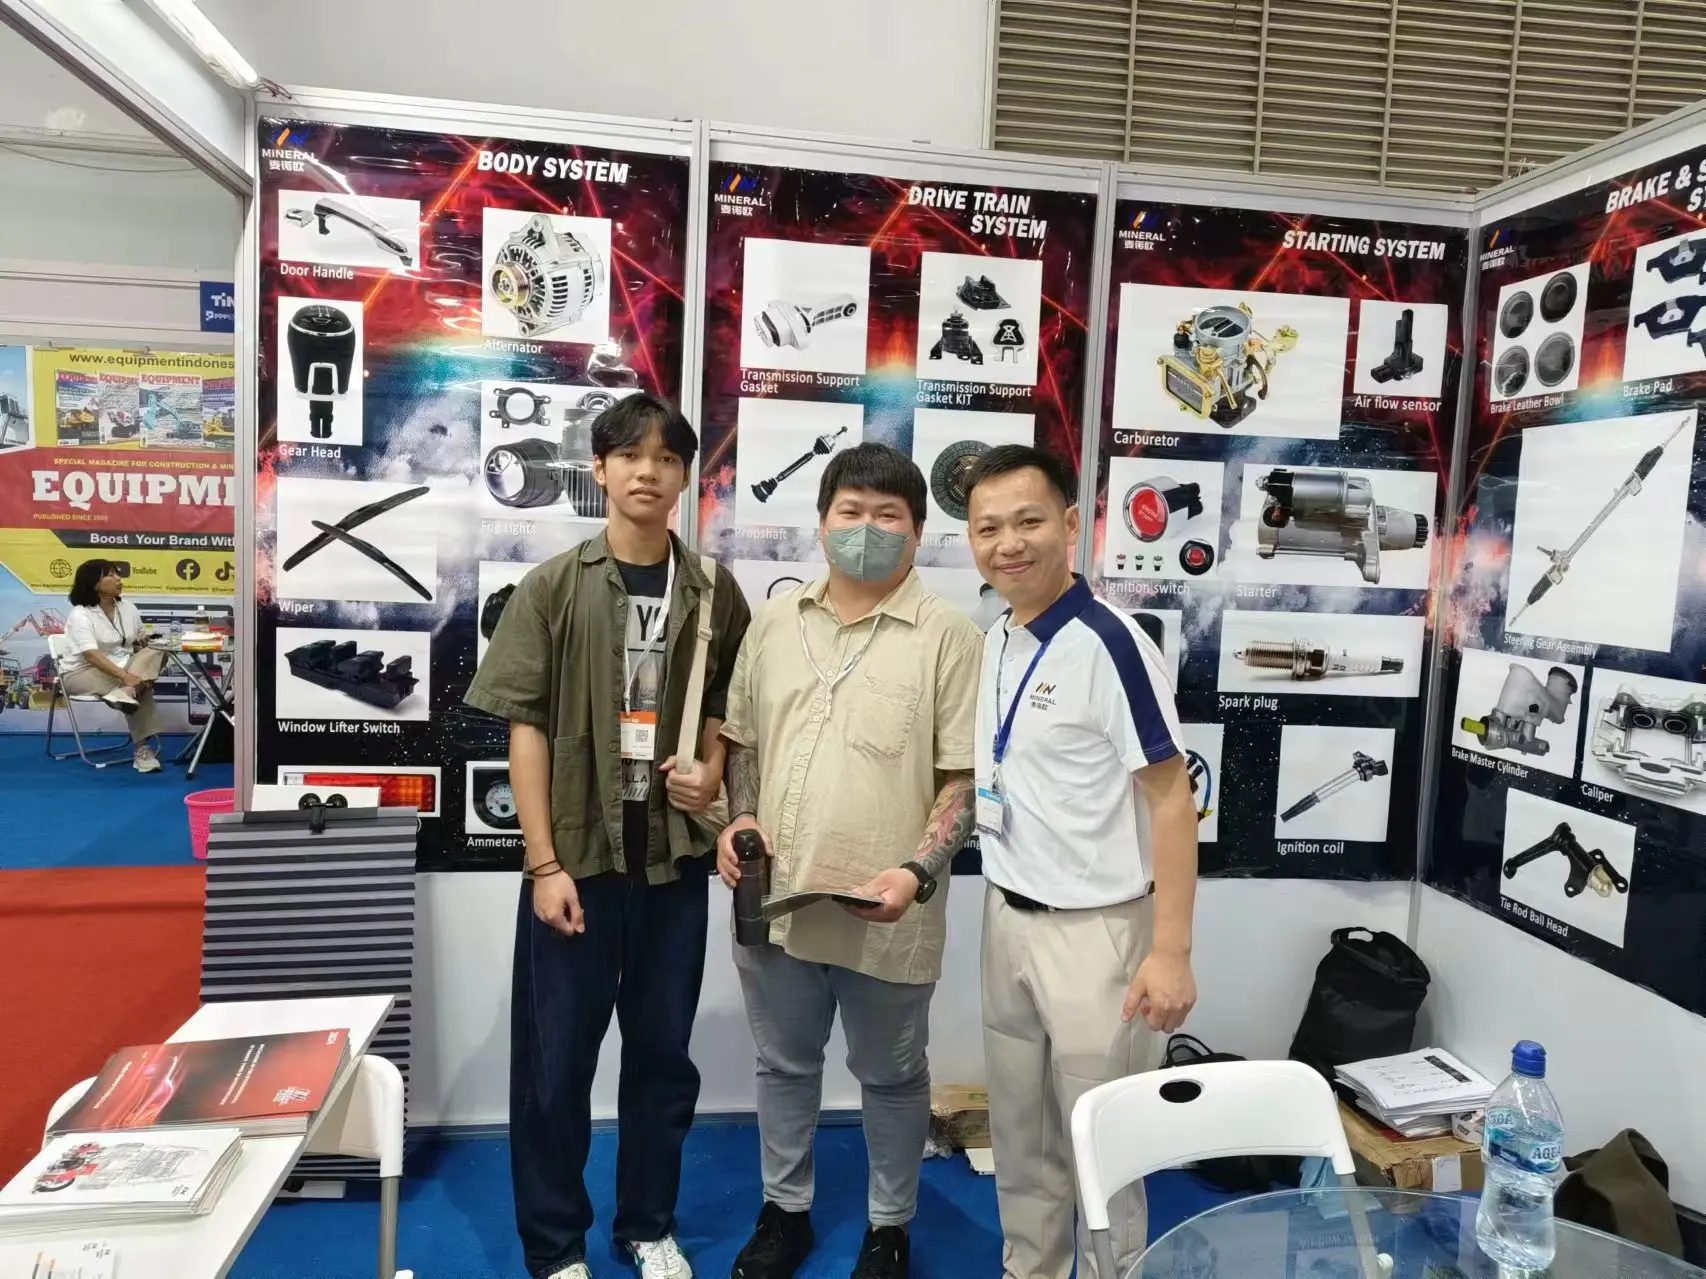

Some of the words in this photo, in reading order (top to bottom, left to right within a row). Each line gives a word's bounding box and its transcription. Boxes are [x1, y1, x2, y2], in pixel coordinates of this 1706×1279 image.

[478, 150, 539, 176] BODY
[543, 157, 629, 184] SYSTEM
[1605, 170, 1672, 214] BRAKE
[1675, 164, 1692, 190] &
[714, 193, 766, 207] MINERAL
[908, 186, 969, 209] DRIVE
[973, 192, 1031, 215] TRAIN
[721, 205, 753, 217] 麦诺欧
[970, 214, 1047, 239] SYSTEM
[1118, 230, 1166, 242] MINERAL
[1283, 229, 1370, 256] STARTING
[1374, 238, 1445, 260] SYSTEM
[280, 263, 309, 275] Door
[312, 266, 354, 280] Handle
[484, 339, 543, 354] Alternator
[70, 353, 235, 369] www.equipmentindones
[740, 368, 813, 384] Transmission
[816, 373, 860, 387] Support
[740, 381, 778, 393] Gasket
[917, 380, 986, 394] Transmission
[989, 384, 1031, 398] Support
[1623, 383, 1651, 397] Brake
[1654, 378, 1673, 393] Pad
[916, 391, 953, 404] Gasket
[956, 394, 973, 406] KIT
[1355, 395, 1371, 408] Air
[1375, 396, 1399, 409] flow
[1402, 399, 1441, 412] sensor
[1490, 402, 1512, 414] Brake
[1513, 397, 1541, 412] Leather
[1114, 431, 1179, 447] Carburetor
[278, 444, 307, 457] Gear
[311, 446, 341, 459] Head
[89, 459, 129, 467] MAGAZINE
[149, 461, 209, 469] CONSTRUCTION
[90, 533, 129, 544] Boost
[136, 534, 166, 545] Your
[169, 535, 208, 546] Brand
[734, 528, 787, 542] Propshaft
[1106, 580, 1149, 594] Ignition
[1154, 582, 1190, 594] switch
[1237, 584, 1277, 598] Starter
[279, 600, 315, 614] Wiper
[1504, 633, 1535, 650] Steering
[1536, 638, 1555, 650] Gear
[1030, 694, 1056, 706] MINERAL
[1218, 695, 1250, 711] Spark
[1254, 696, 1278, 711] plug
[278, 721, 326, 734] Window
[330, 721, 359, 734] Lifter
[363, 722, 401, 735] Switch
[1451, 747, 1469, 761] Brake
[1470, 753, 1496, 769] Master
[1497, 761, 1529, 779] Cylinder
[1582, 784, 1614, 803] Caliper
[1277, 841, 1319, 856] Ignition
[1323, 841, 1344, 854] coil
[1500, 898, 1512, 912] Tie
[1513, 902, 1527, 917] Rod
[1530, 909, 1544, 926] Ball
[1546, 915, 1568, 936] Head
